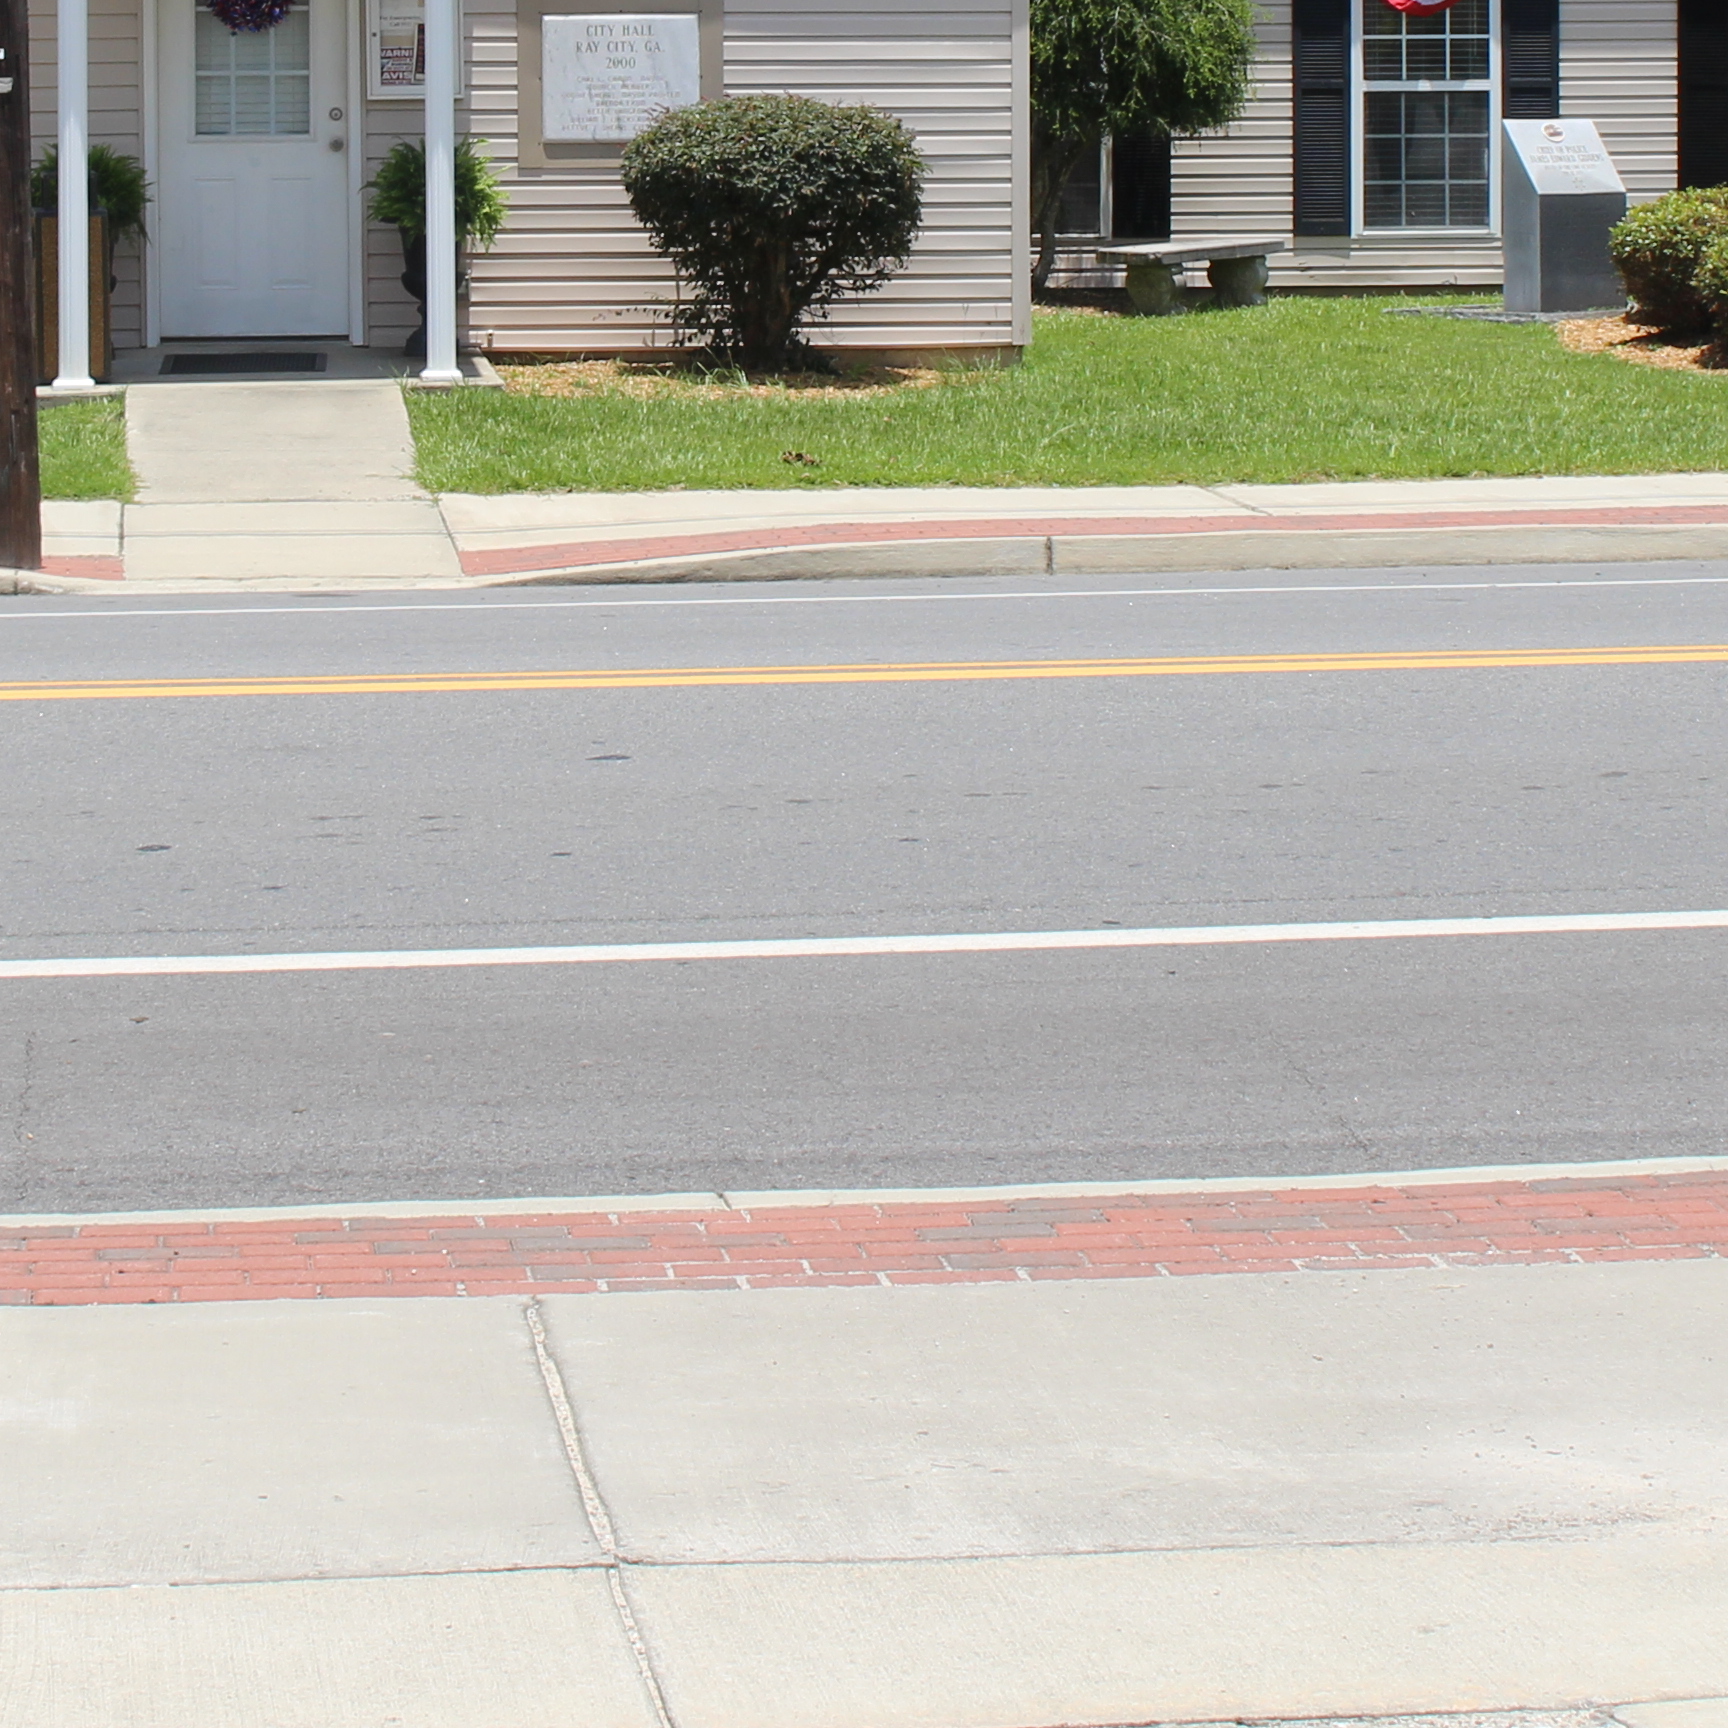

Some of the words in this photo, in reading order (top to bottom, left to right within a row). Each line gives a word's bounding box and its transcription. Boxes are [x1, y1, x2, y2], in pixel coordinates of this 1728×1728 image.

[586, 25, 616, 37] CITY
[622, 25, 655, 37] HALL
[576, 41, 601, 53] RAY
[644, 41, 666, 53] GA.
[605, 56, 637, 69] 2000
